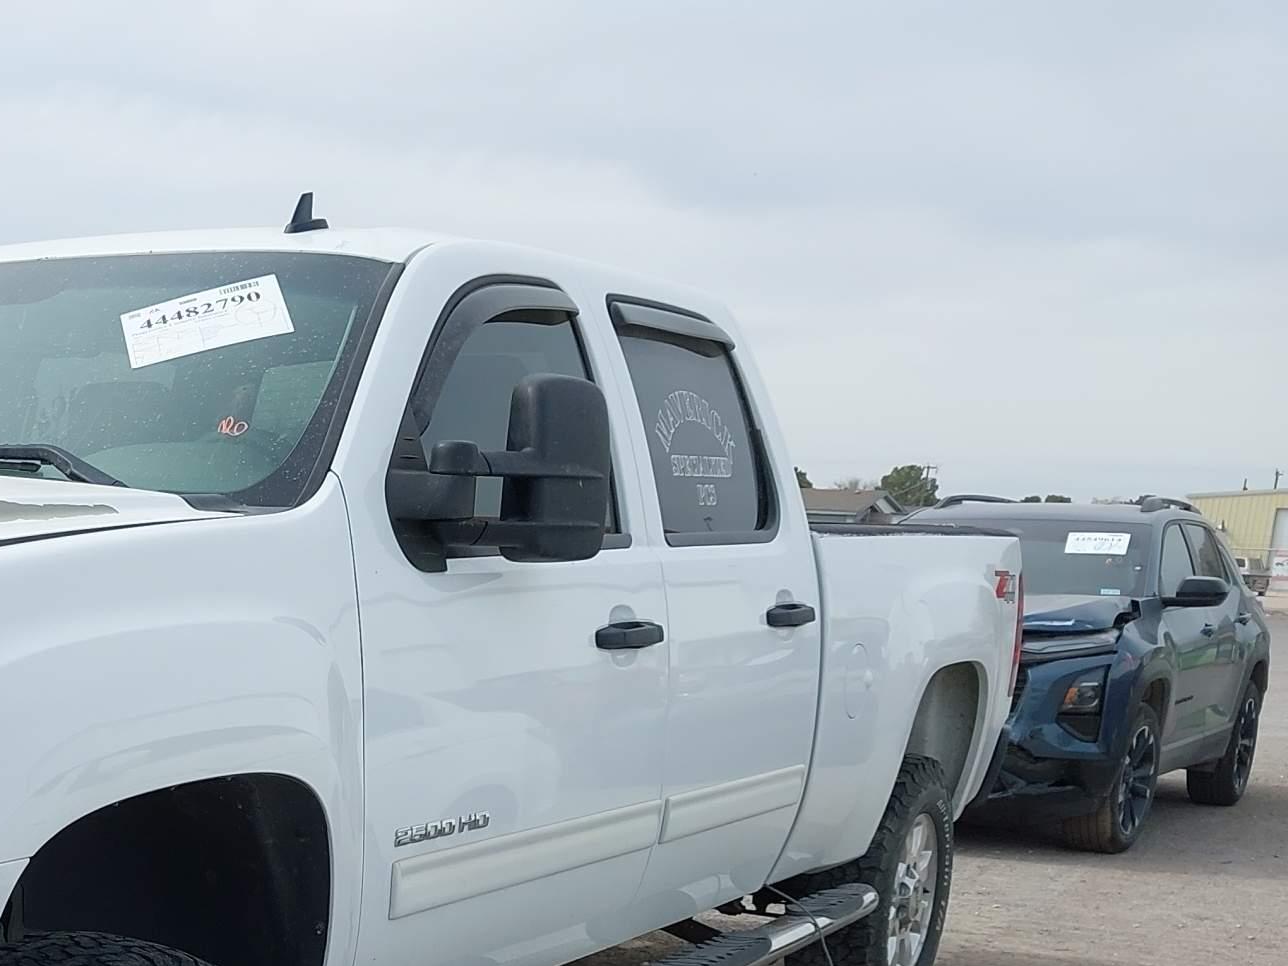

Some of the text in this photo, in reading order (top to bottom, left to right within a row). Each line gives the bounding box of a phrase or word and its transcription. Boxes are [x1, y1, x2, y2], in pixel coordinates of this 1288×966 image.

[139, 291, 261, 330] 44482790
[394, 811, 490, 848] 2500 HD
